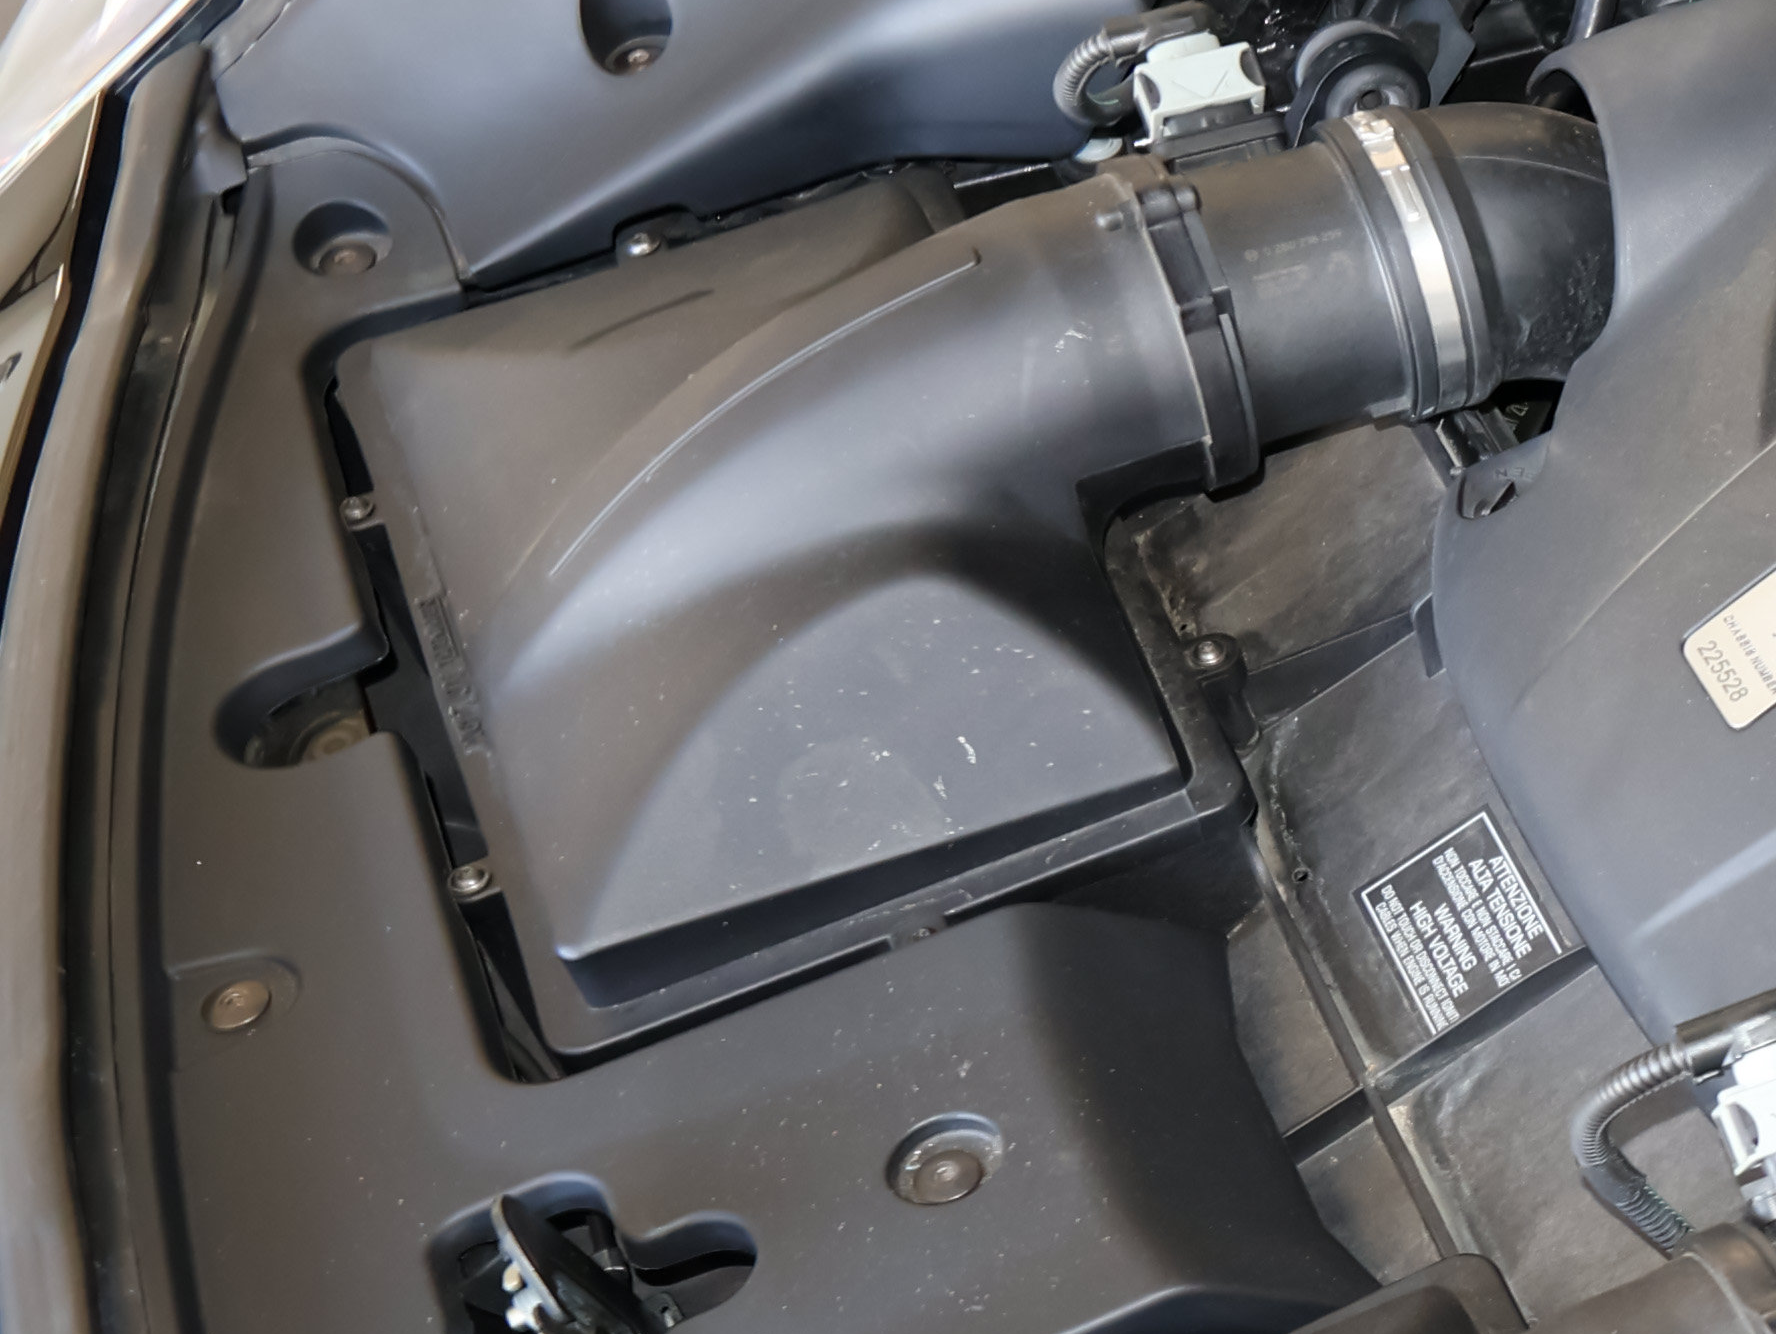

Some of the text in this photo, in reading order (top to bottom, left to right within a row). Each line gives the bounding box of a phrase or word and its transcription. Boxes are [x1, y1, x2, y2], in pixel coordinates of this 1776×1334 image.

[1697, 638, 1749, 703] 225528
[1443, 847, 1460, 867] NON
[1380, 883, 1395, 900] DO
[1453, 866, 1477, 899] TOCCARE
[1488, 854, 1542, 938] ATTENZIONE
[1387, 896, 1404, 916] NOT
[1460, 908, 1477, 929] CON
[1468, 857, 1530, 957] ALTA TENSIONE
[1470, 898, 1482, 909] E
[1475, 906, 1492, 927] NON
[1395, 913, 1416, 940] TOUCH
[1433, 903, 1476, 971] WARNING
[1375, 901, 1397, 931] CABLES
[1390, 930, 1410, 957] WHEN
[1403, 955, 1424, 984] ENGINE
[1417, 983, 1430, 996] IS
[1408, 938, 1423, 954] OR
[1409, 900, 1467, 996] HIGH VOLTAGE
[1470, 927, 1494, 960] MOTORE
[1485, 926, 1512, 964] STACCARE
[1416, 951, 1446, 999] DISCONNECT
[1487, 958, 1501, 972] IN
[1493, 969, 1509, 989] MO
